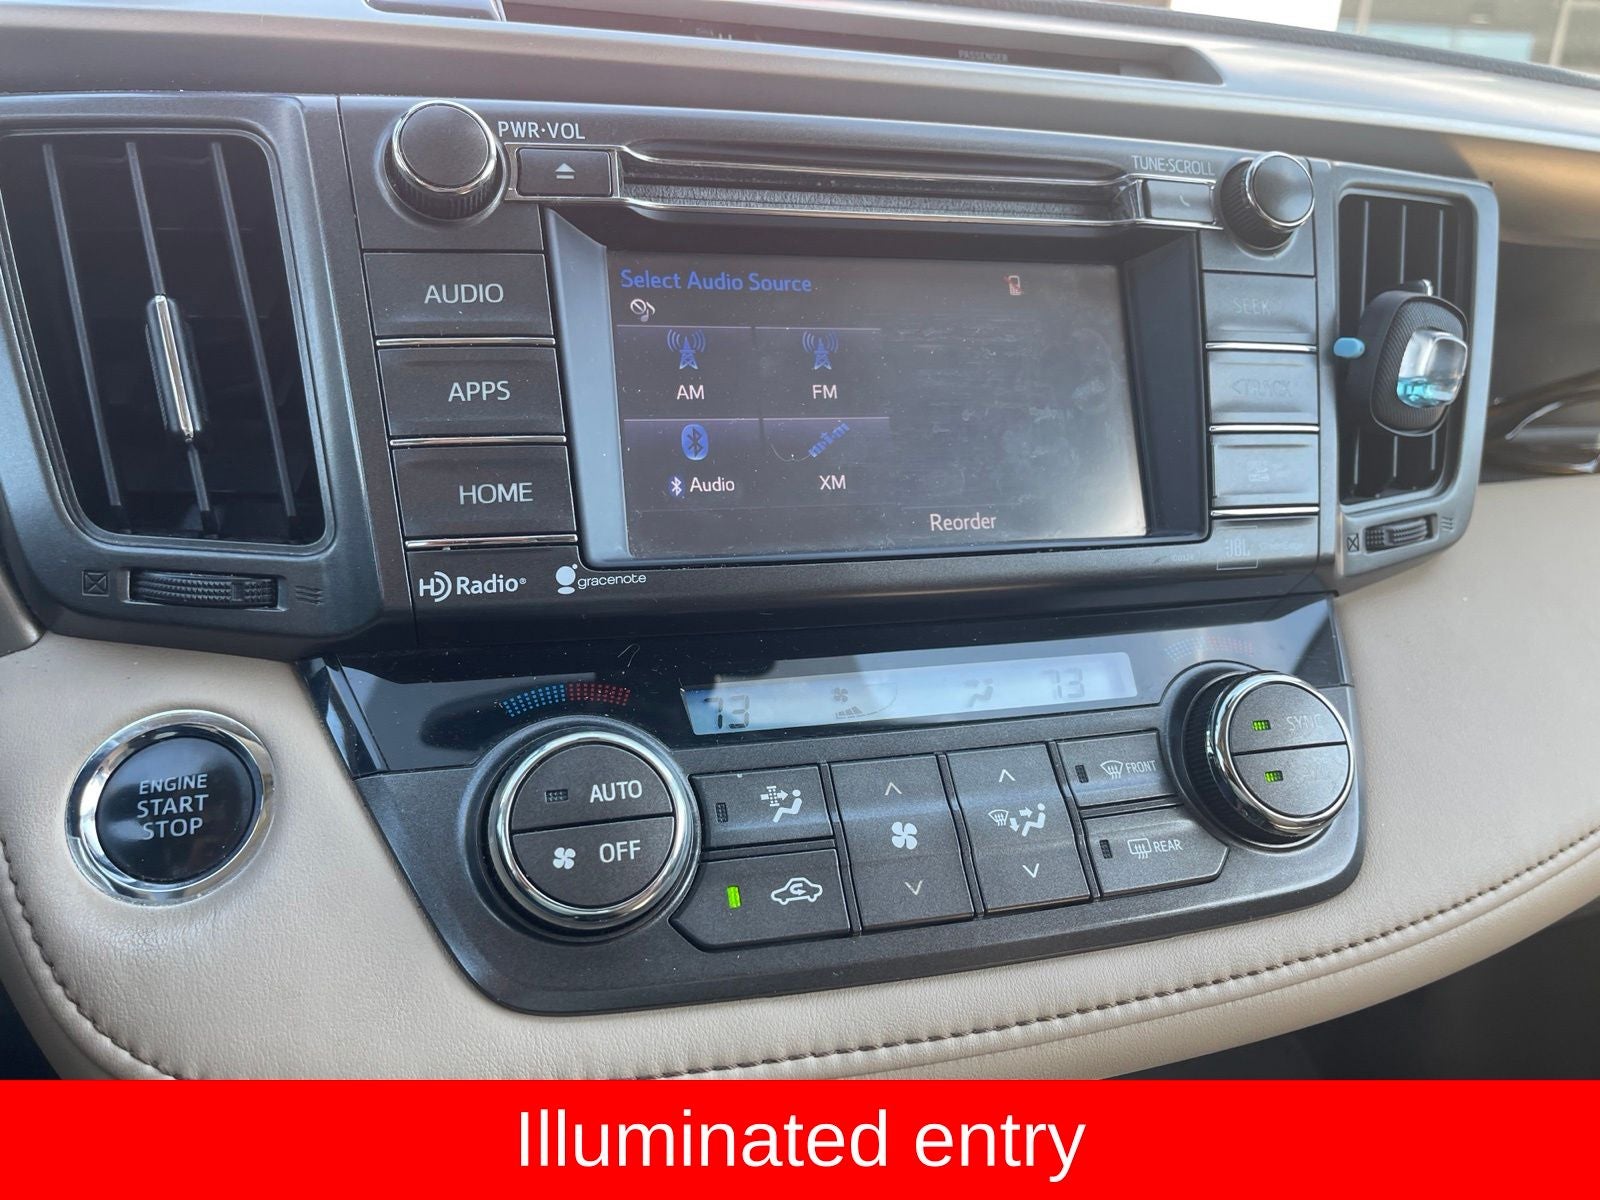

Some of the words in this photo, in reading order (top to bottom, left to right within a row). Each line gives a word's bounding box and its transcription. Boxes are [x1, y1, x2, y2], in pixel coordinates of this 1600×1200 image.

[620, 269, 681, 289] Select
[687, 271, 744, 291] Audio
[749, 273, 812, 292] Source
[424, 283, 504, 304] AUDIO
[448, 380, 511, 402] APPS
[676, 384, 705, 400] AM
[812, 384, 838, 399] FM
[689, 476, 735, 492] Audio
[819, 475, 847, 490] XM
[459, 482, 533, 505] HOME
[930, 512, 997, 532] Reorder
[577, 573, 647, 590] gracenote
[1126, 760, 1157, 774] FRONT
[138, 774, 208, 795] ENGINE
[589, 779, 643, 803] AUTO
[136, 794, 209, 819] START
[141, 817, 203, 840] STOP
[600, 840, 641, 863] OFF
[1153, 839, 1183, 853] REAR
